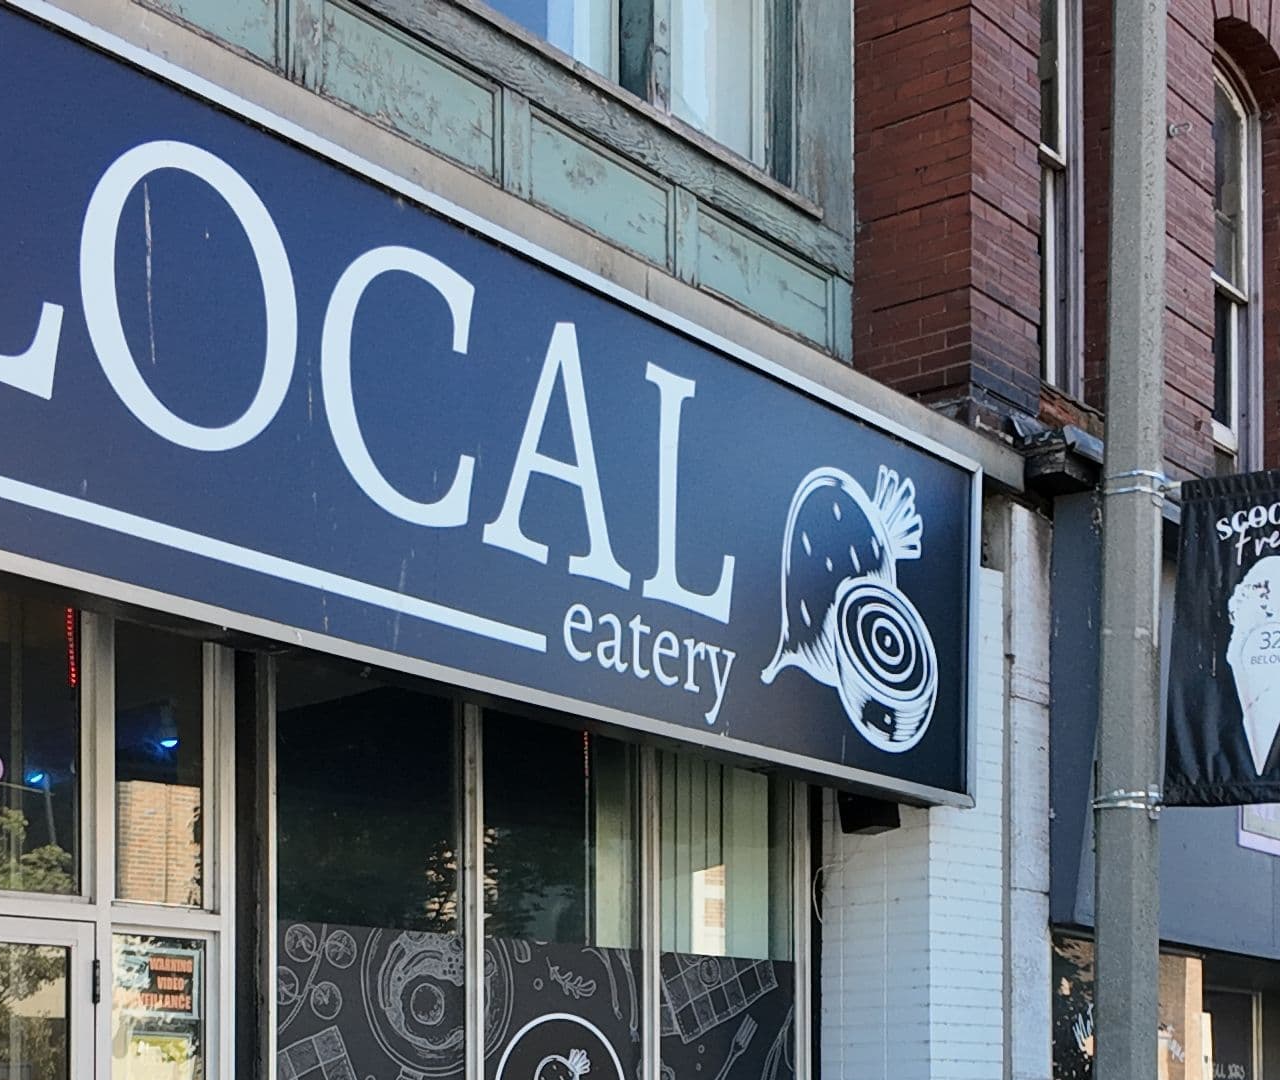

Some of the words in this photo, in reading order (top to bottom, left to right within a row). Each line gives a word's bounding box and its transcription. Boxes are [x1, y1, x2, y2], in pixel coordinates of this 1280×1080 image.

[561, 599, 736, 724] eatery
[149, 957, 193, 973] WARNING
[156, 976, 185, 991] VIDEO
